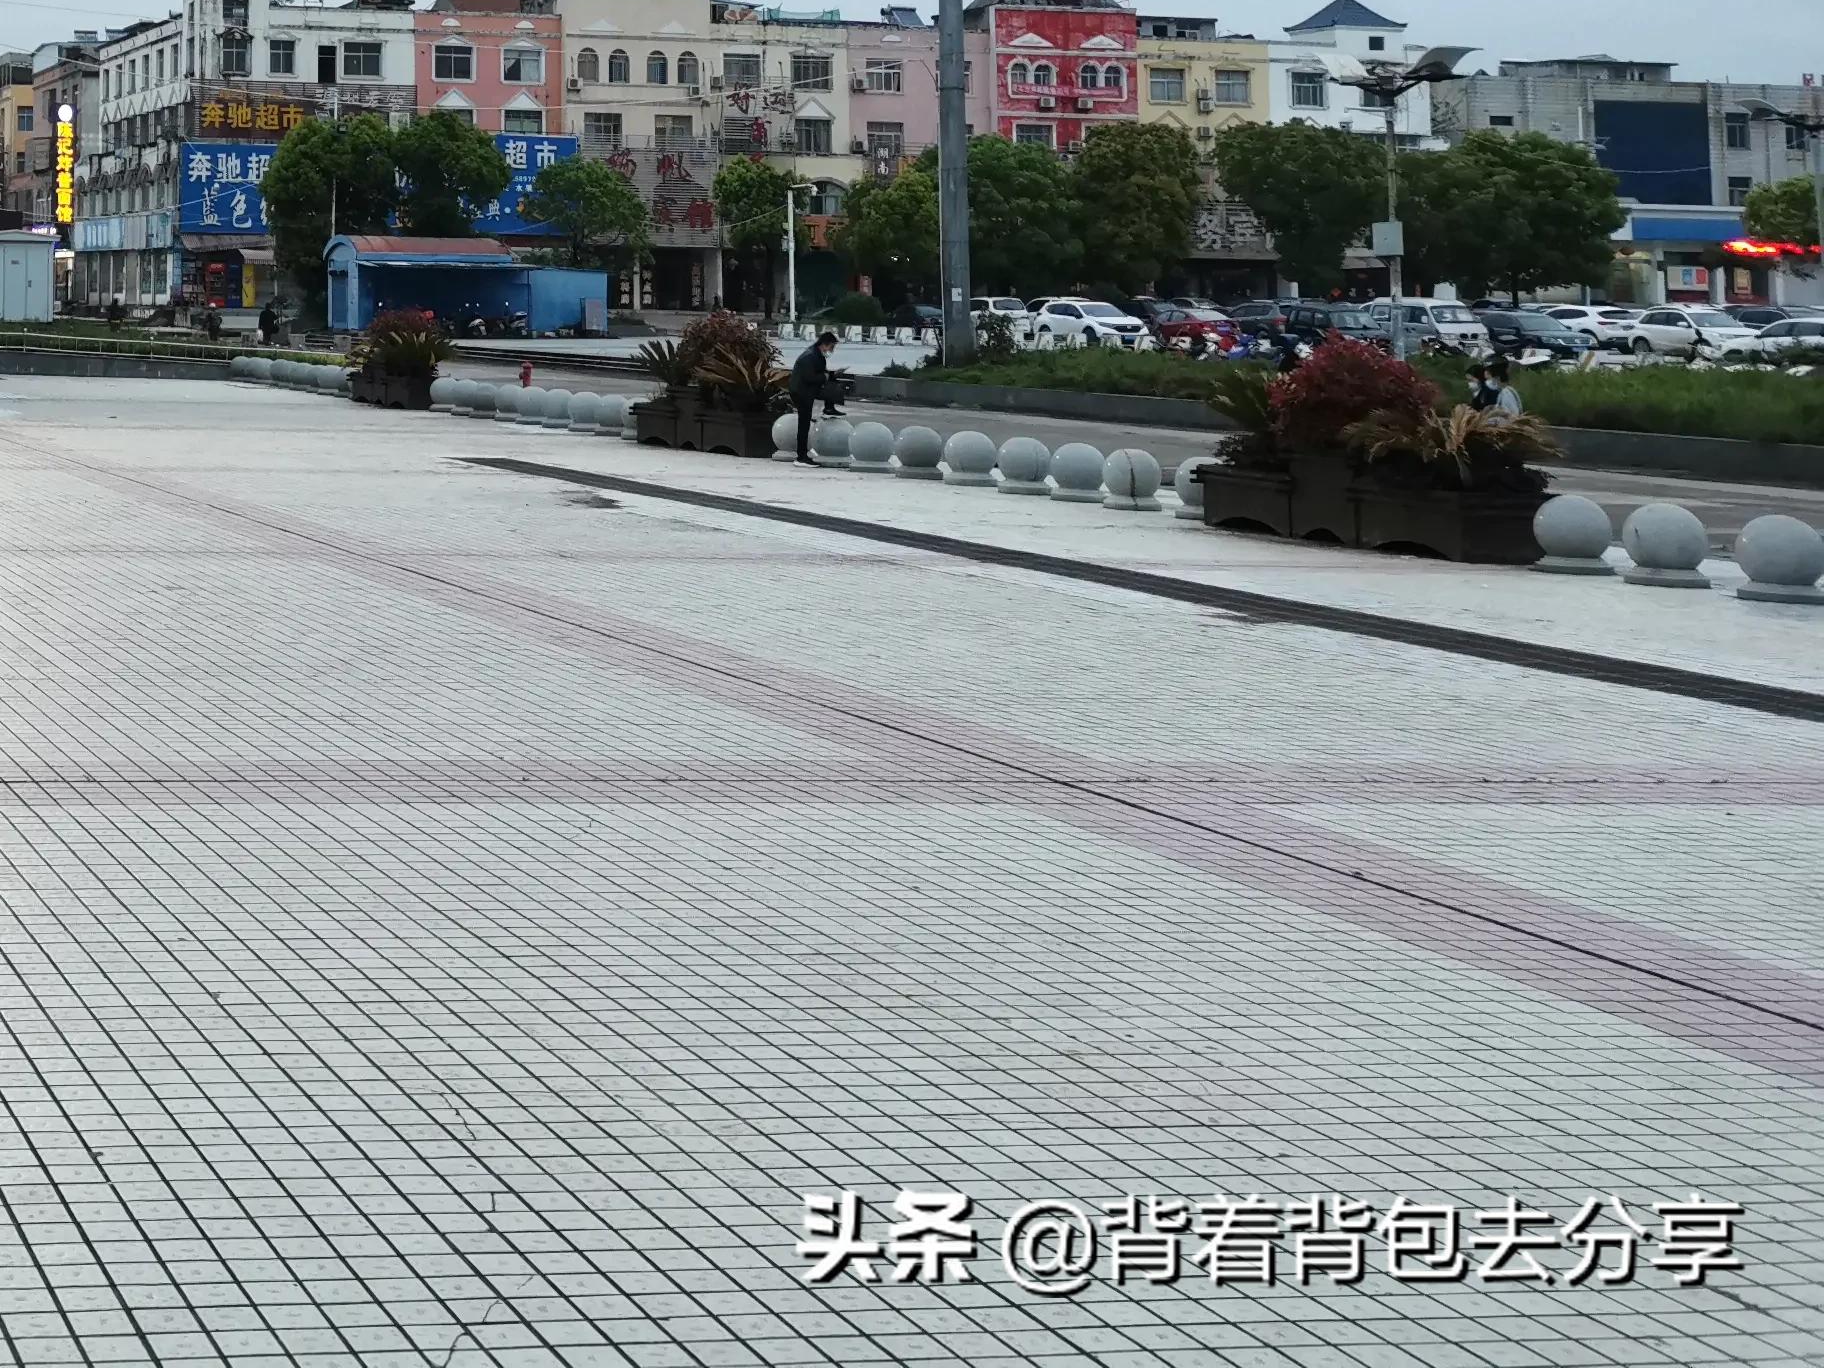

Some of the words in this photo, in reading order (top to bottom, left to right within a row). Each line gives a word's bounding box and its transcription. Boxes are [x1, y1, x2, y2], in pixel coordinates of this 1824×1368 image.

[201, 102, 305, 129] 奔驰超市
[505, 139, 557, 170] 超市
